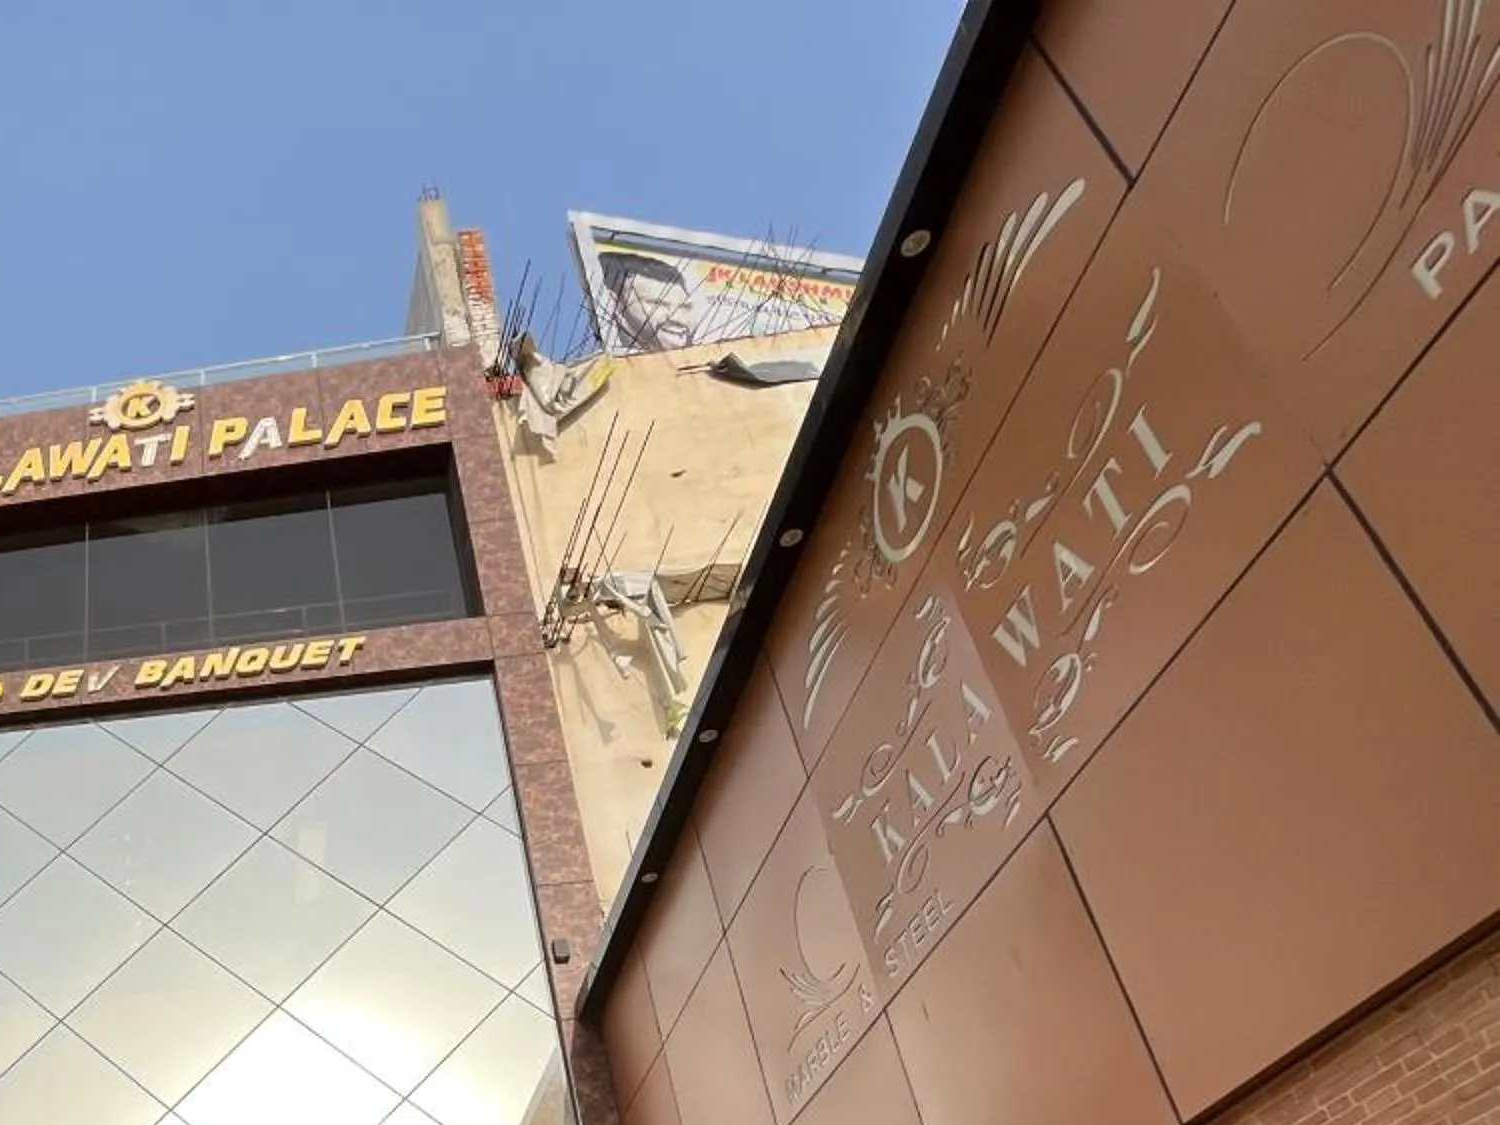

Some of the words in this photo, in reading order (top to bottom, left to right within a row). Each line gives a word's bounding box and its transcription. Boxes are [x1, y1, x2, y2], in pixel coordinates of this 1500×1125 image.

[208, 387, 447, 460] PALACE
[19, 669, 118, 701] DEV
[134, 635, 366, 690] BANQUET
[885, 892, 954, 978] STEEL
